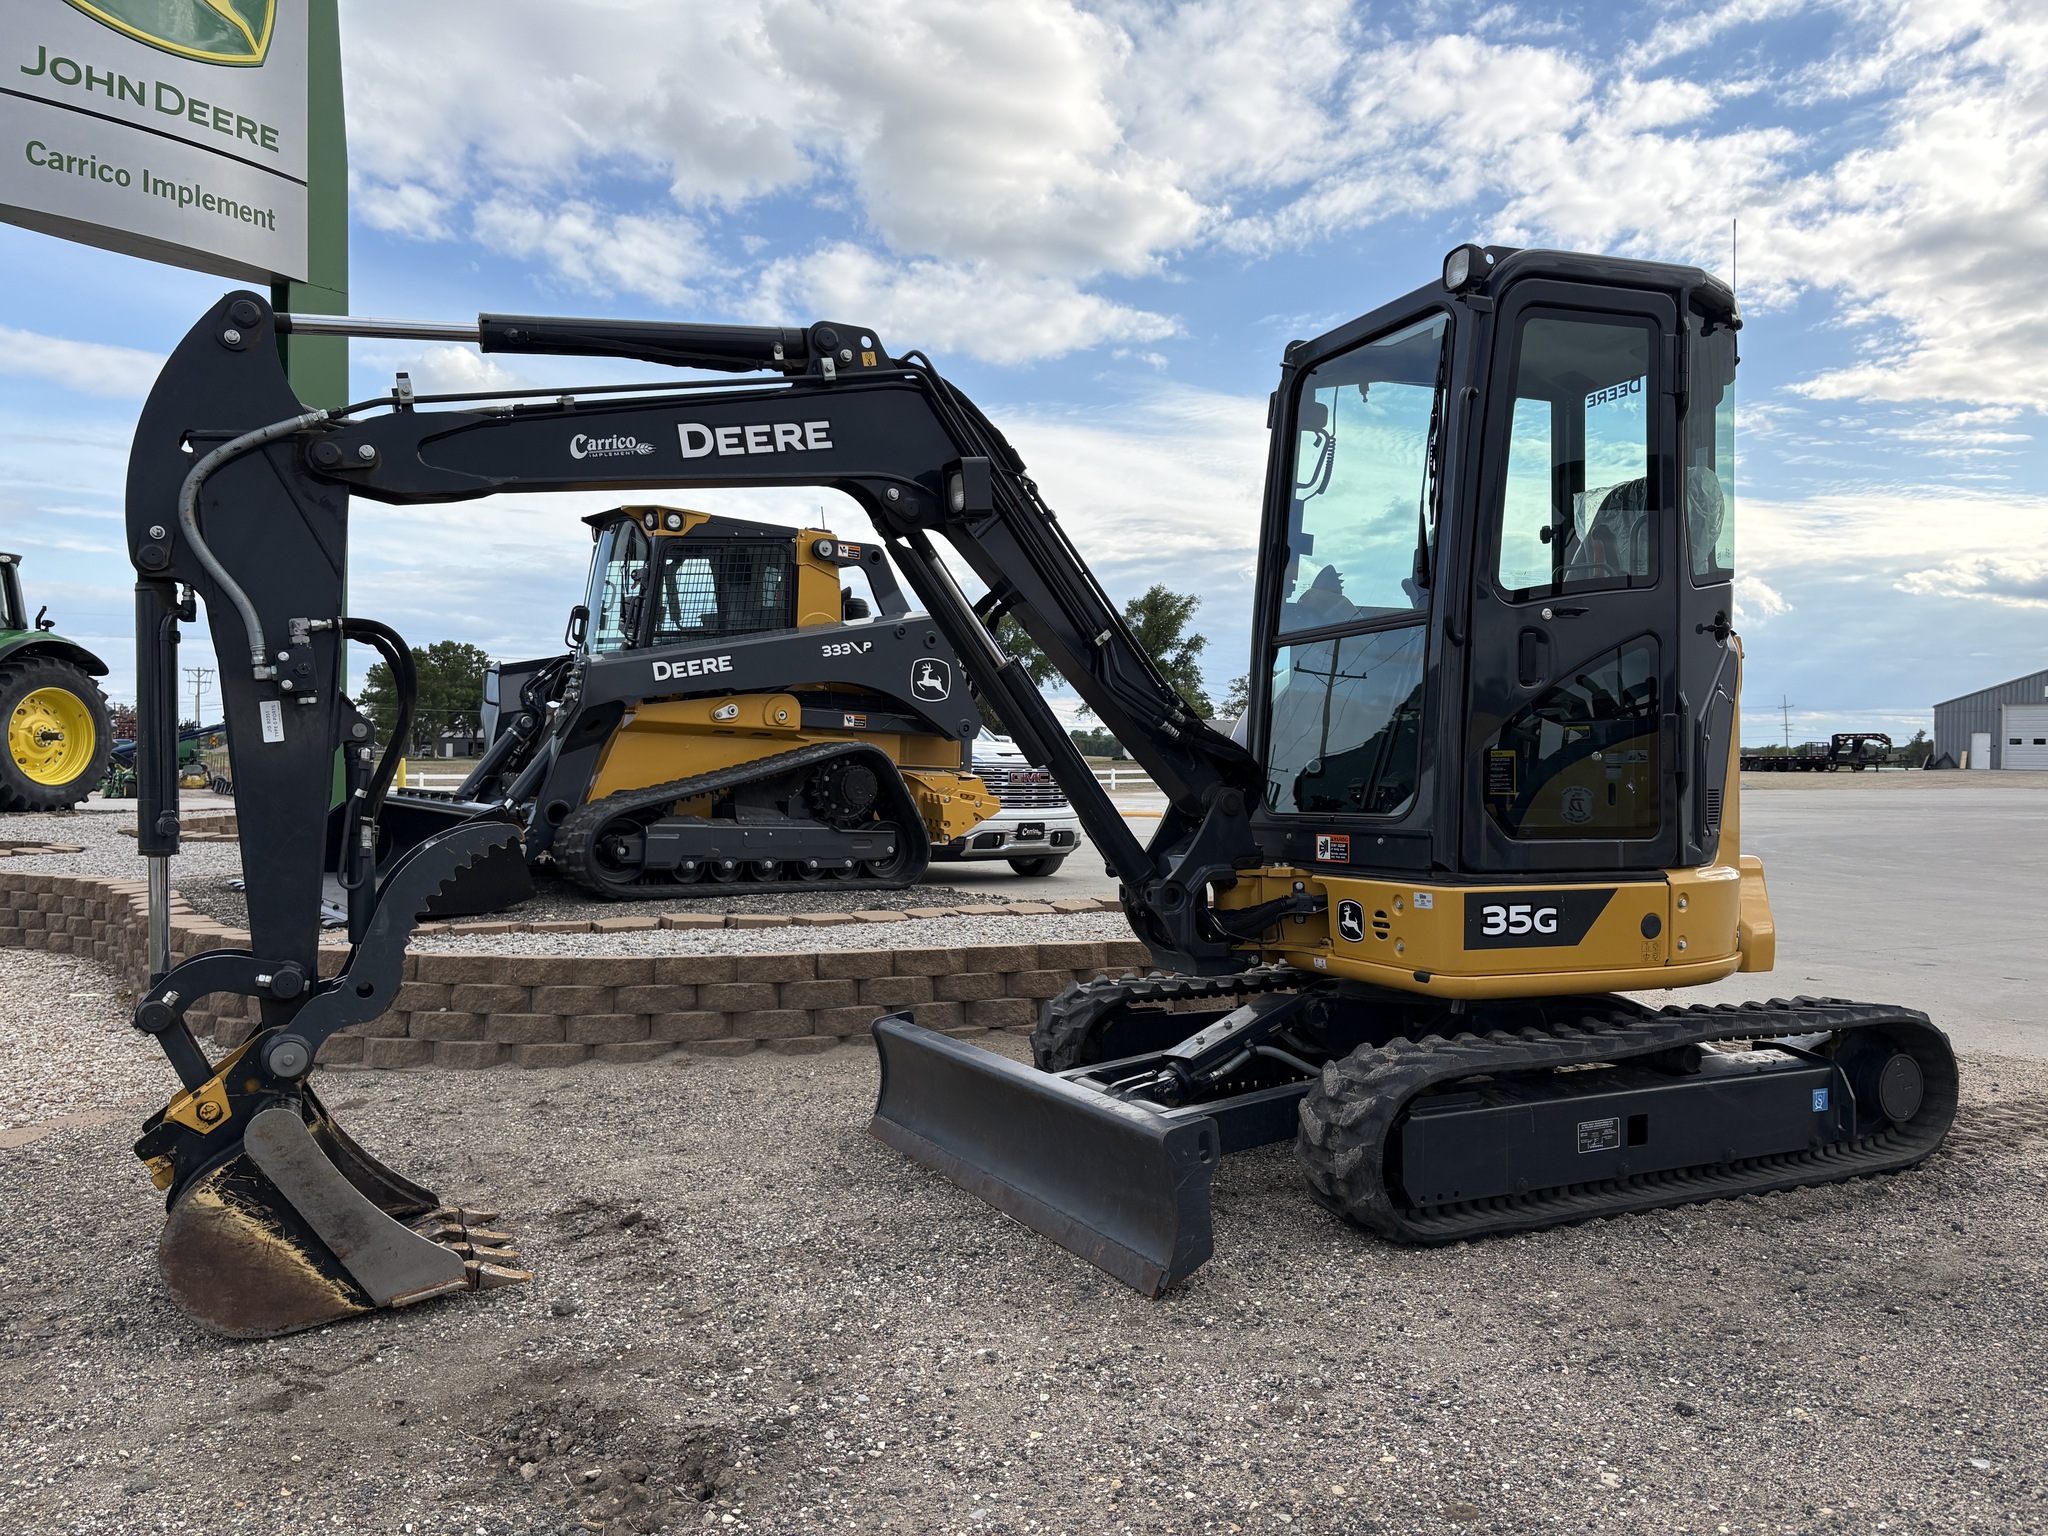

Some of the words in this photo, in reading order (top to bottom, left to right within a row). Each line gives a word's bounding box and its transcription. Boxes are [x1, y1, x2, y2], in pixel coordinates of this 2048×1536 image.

[20, 45, 146, 107] JOHN
[154, 80, 279, 153] DEERE
[25, 140, 131, 187] Carrico
[143, 169, 276, 232] Implement
[570, 434, 636, 459] Carrico
[677, 420, 833, 459] DEERE
[652, 655, 733, 682] DEERE
[1011, 772, 1049, 783] GMC
[1482, 905, 1557, 935] 35G
